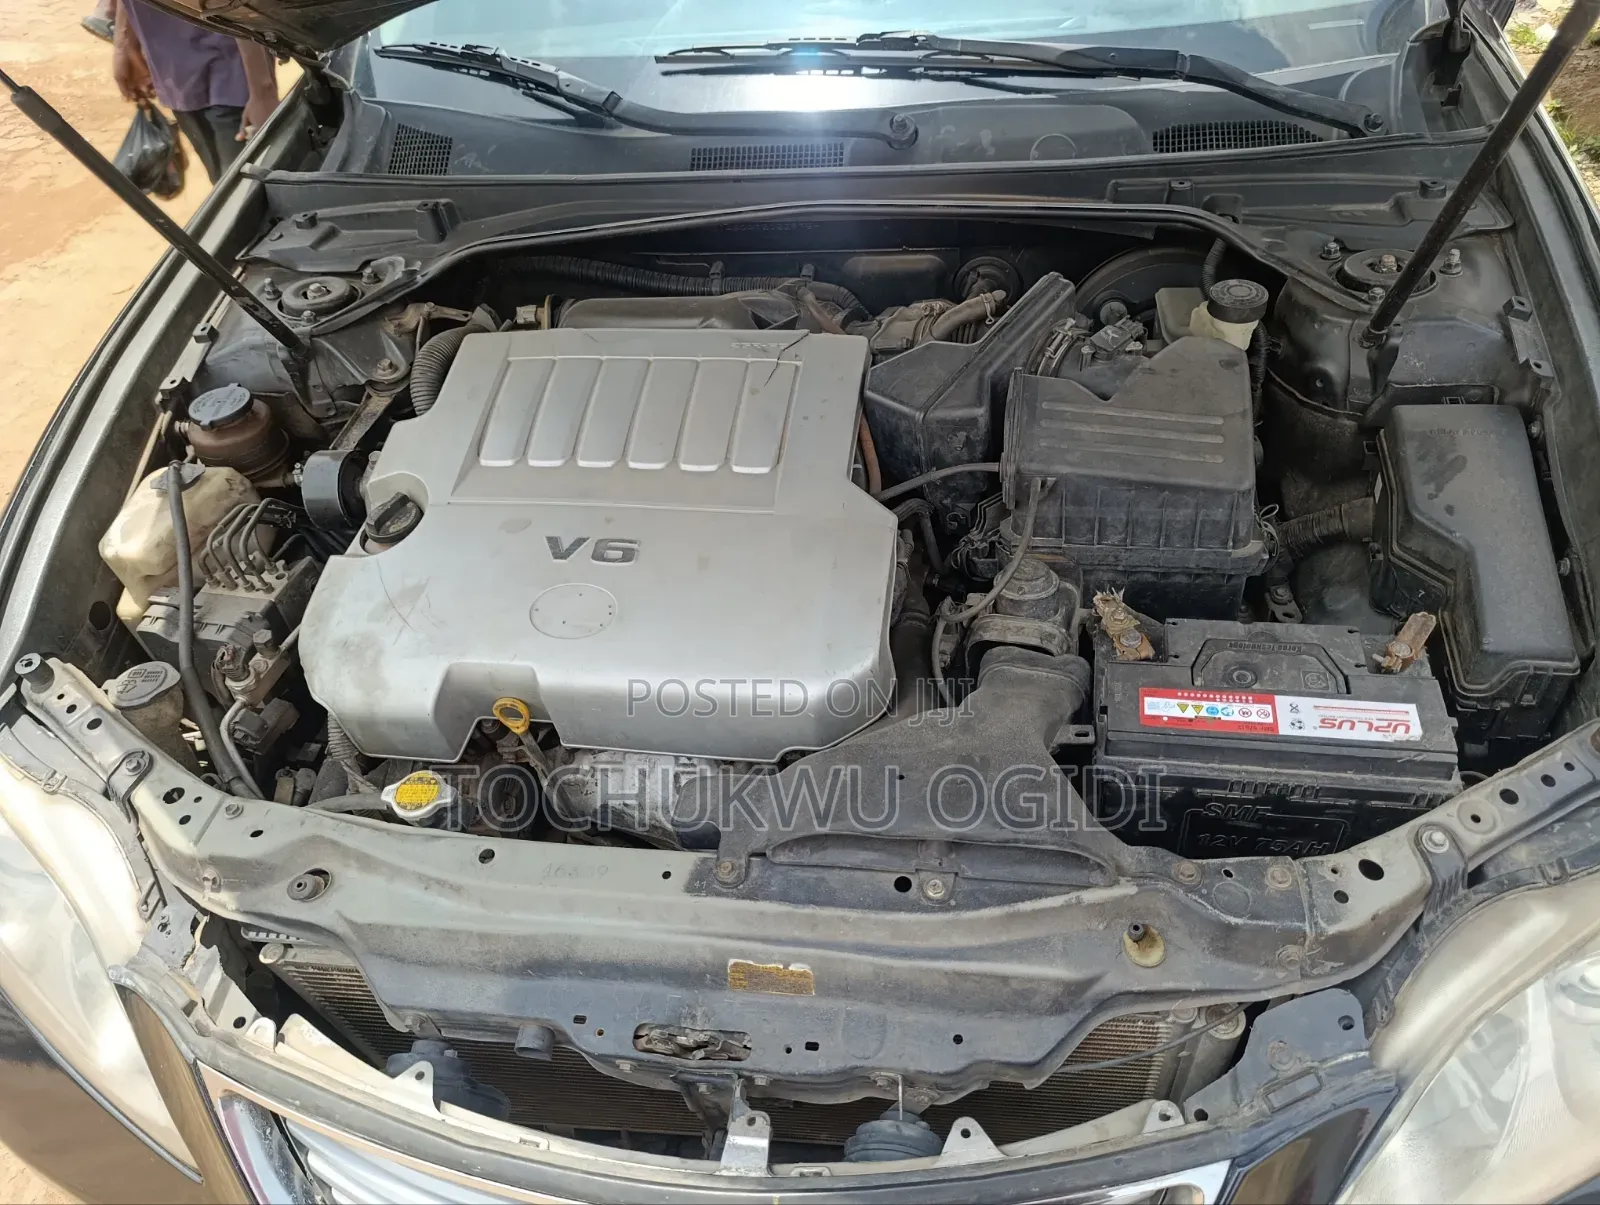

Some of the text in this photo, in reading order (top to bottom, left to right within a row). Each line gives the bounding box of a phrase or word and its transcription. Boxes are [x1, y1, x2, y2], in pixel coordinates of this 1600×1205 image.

[545, 535, 641, 567] V6
[1318, 718, 1411, 734] UPLUS
[1203, 802, 1273, 821] SMF
[1198, 833, 1330, 855] 12V 75AH
